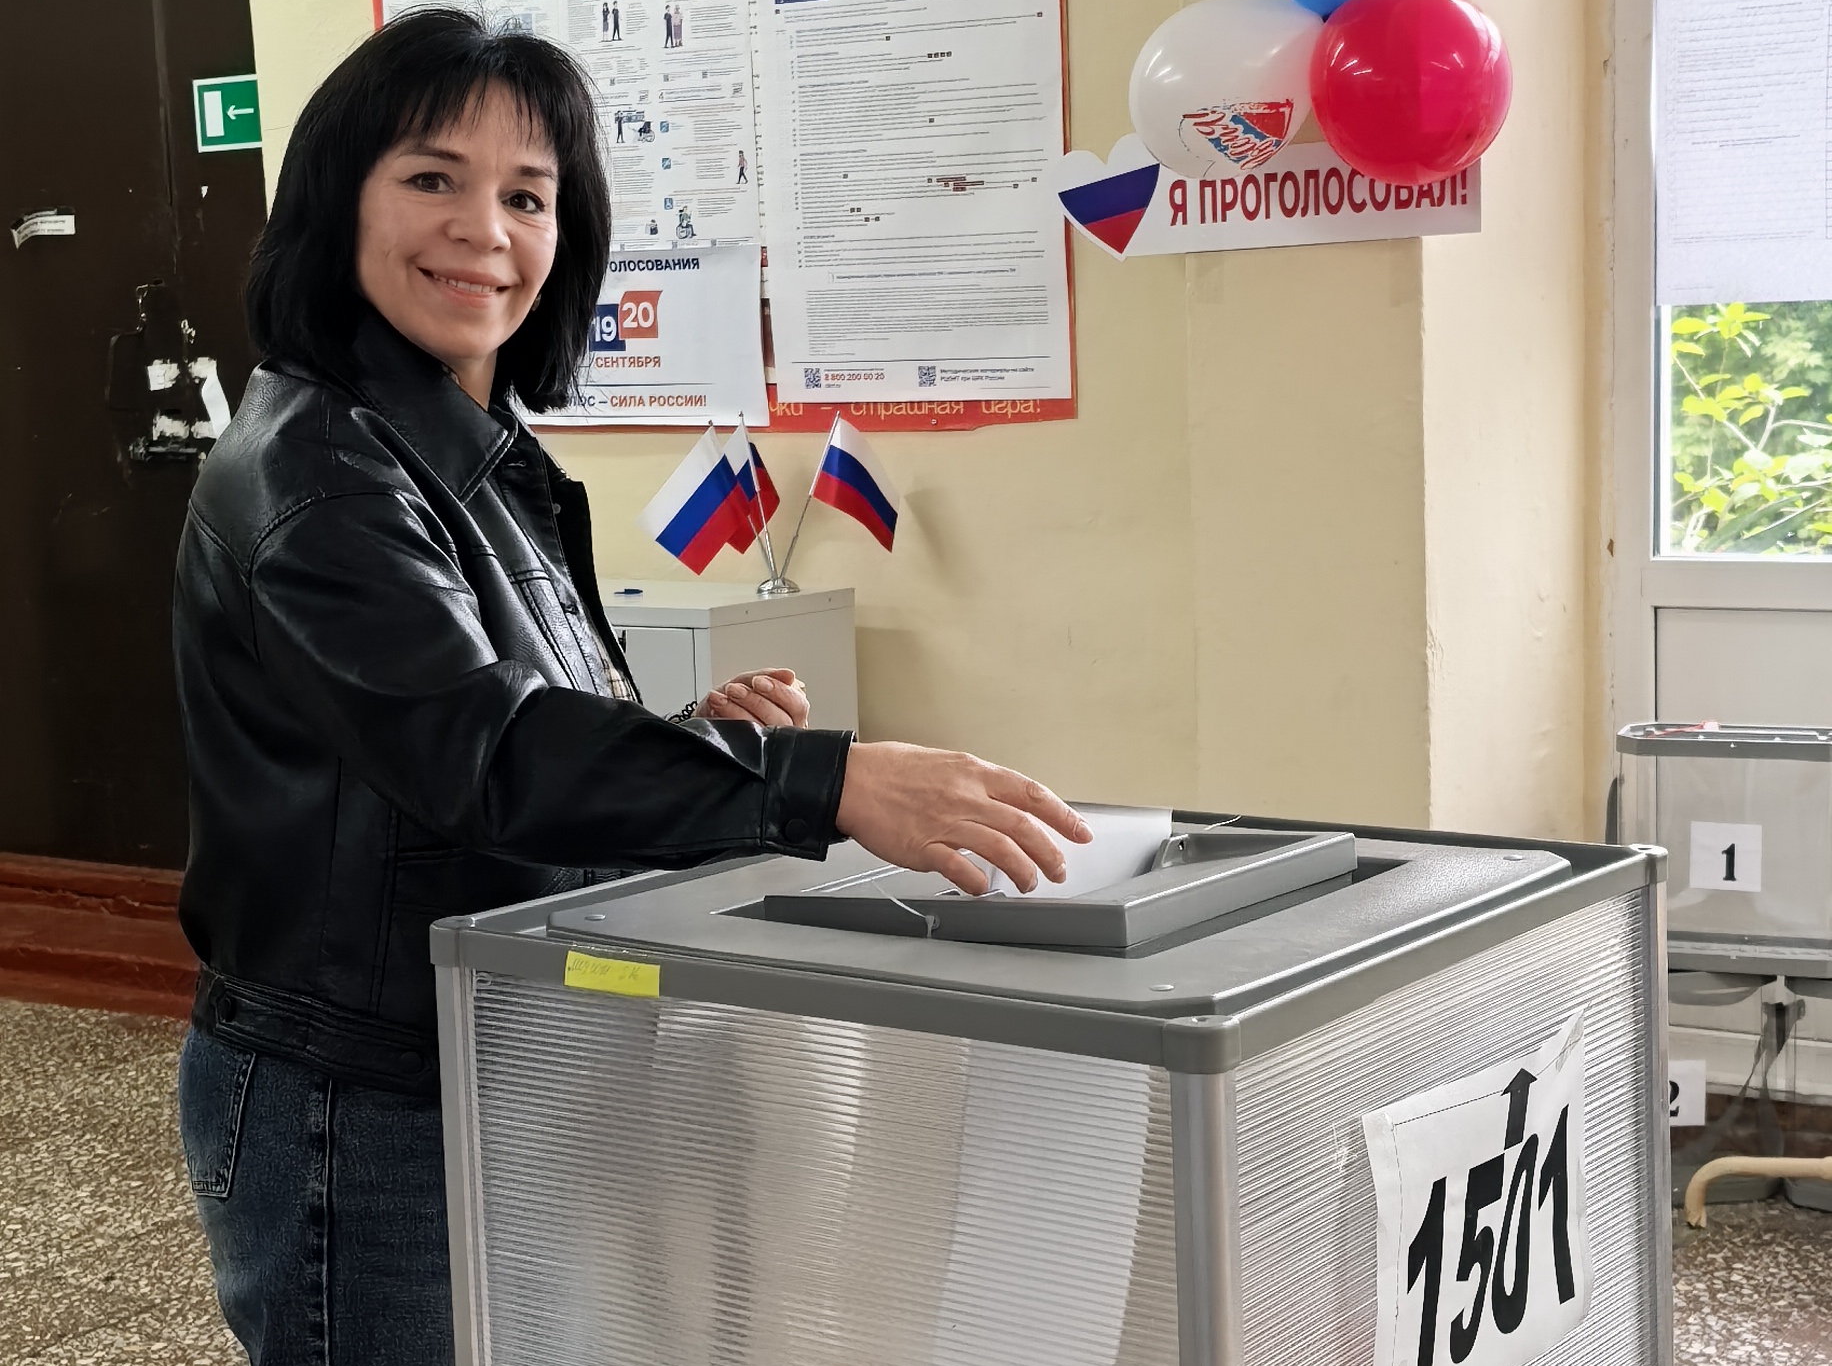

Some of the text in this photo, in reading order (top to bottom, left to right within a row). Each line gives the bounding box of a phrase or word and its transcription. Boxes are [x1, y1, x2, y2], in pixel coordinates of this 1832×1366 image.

[1168, 166, 1468, 226] Я ПРОГОЛОСОВАЛ!
[609, 257, 700, 273] ОЛОСОВАНИЯ
[594, 301, 655, 343] 19 20
[595, 355, 662, 369] СЕНТЯБРЯ
[609, 395, 646, 408] СИЛА
[649, 394, 707, 407] РОССИИ!
[768, 402, 804, 417] чки
[1721, 842, 1737, 882] 1
